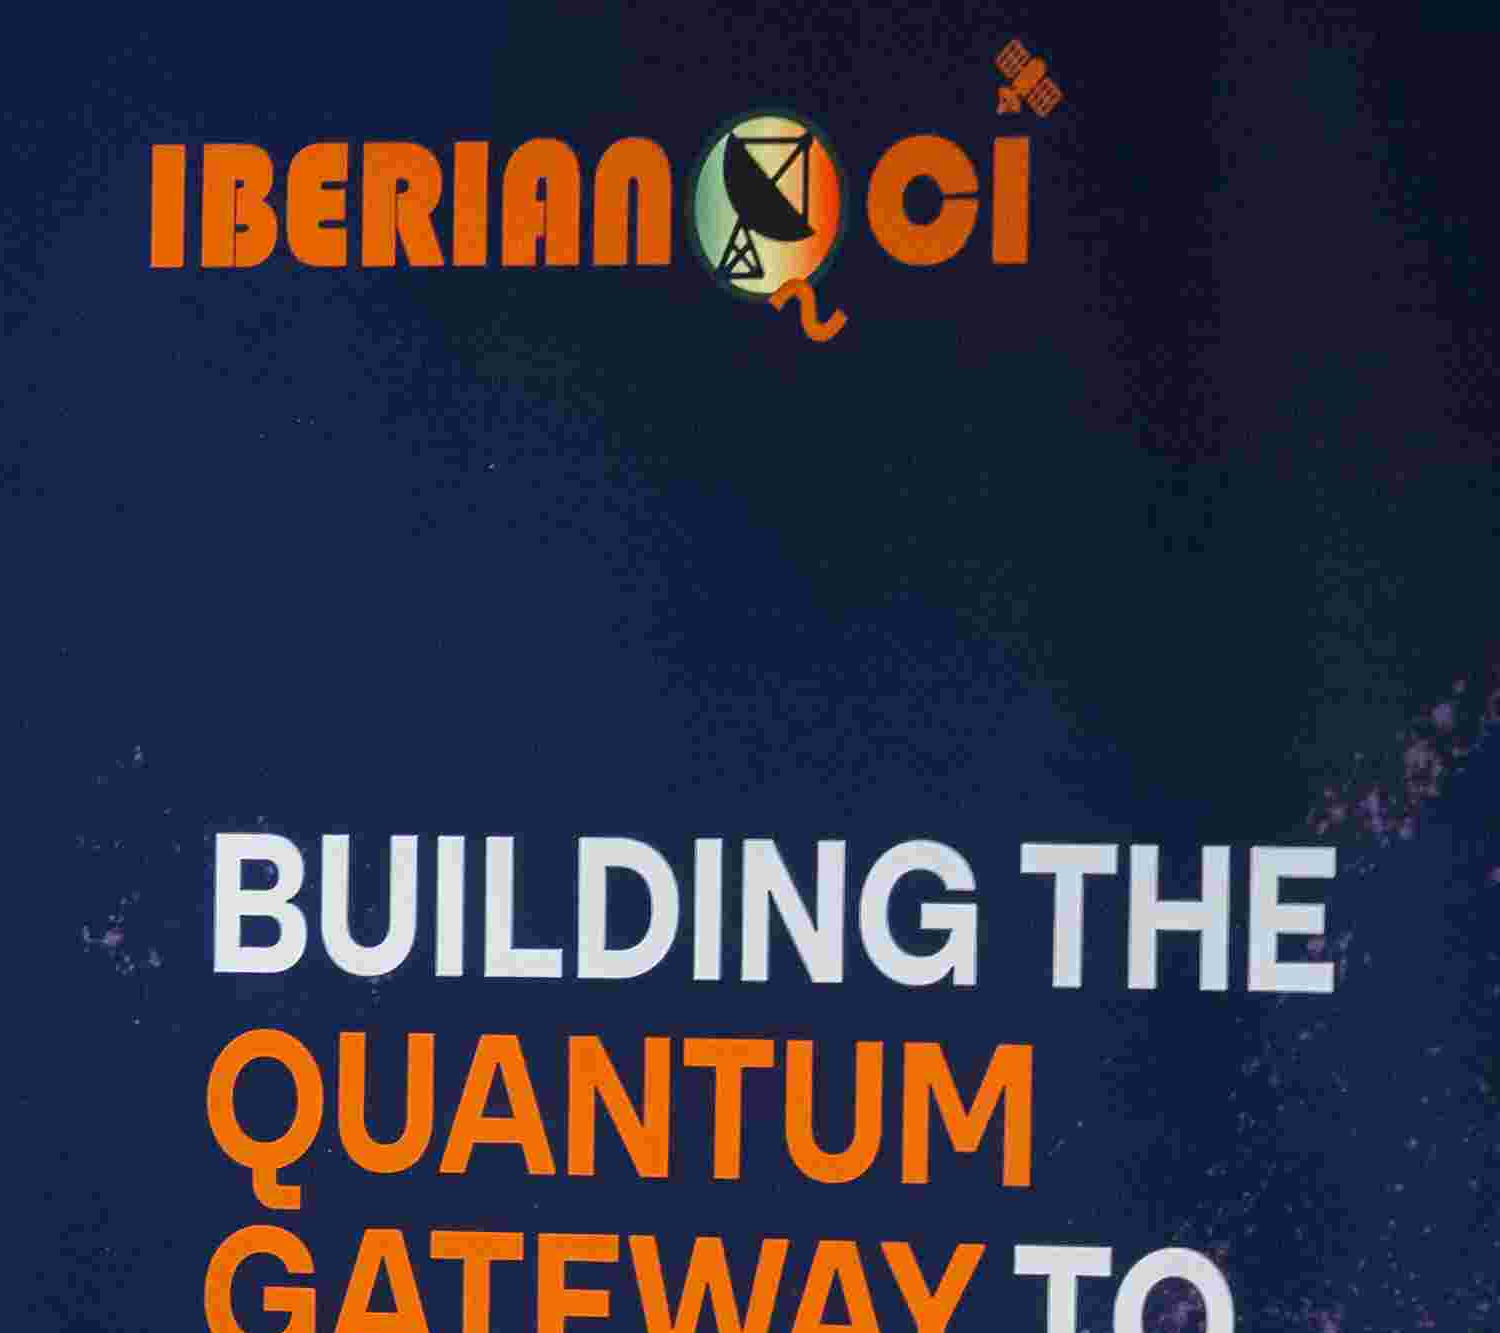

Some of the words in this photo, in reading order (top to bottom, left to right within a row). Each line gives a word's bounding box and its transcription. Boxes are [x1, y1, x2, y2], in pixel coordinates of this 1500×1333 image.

[150, 137, 672, 268] IBERIAN
[213, 832, 978, 986] BUILDING
[1020, 842, 1336, 993] THE
[206, 1028, 1033, 1210] QUANTUM
